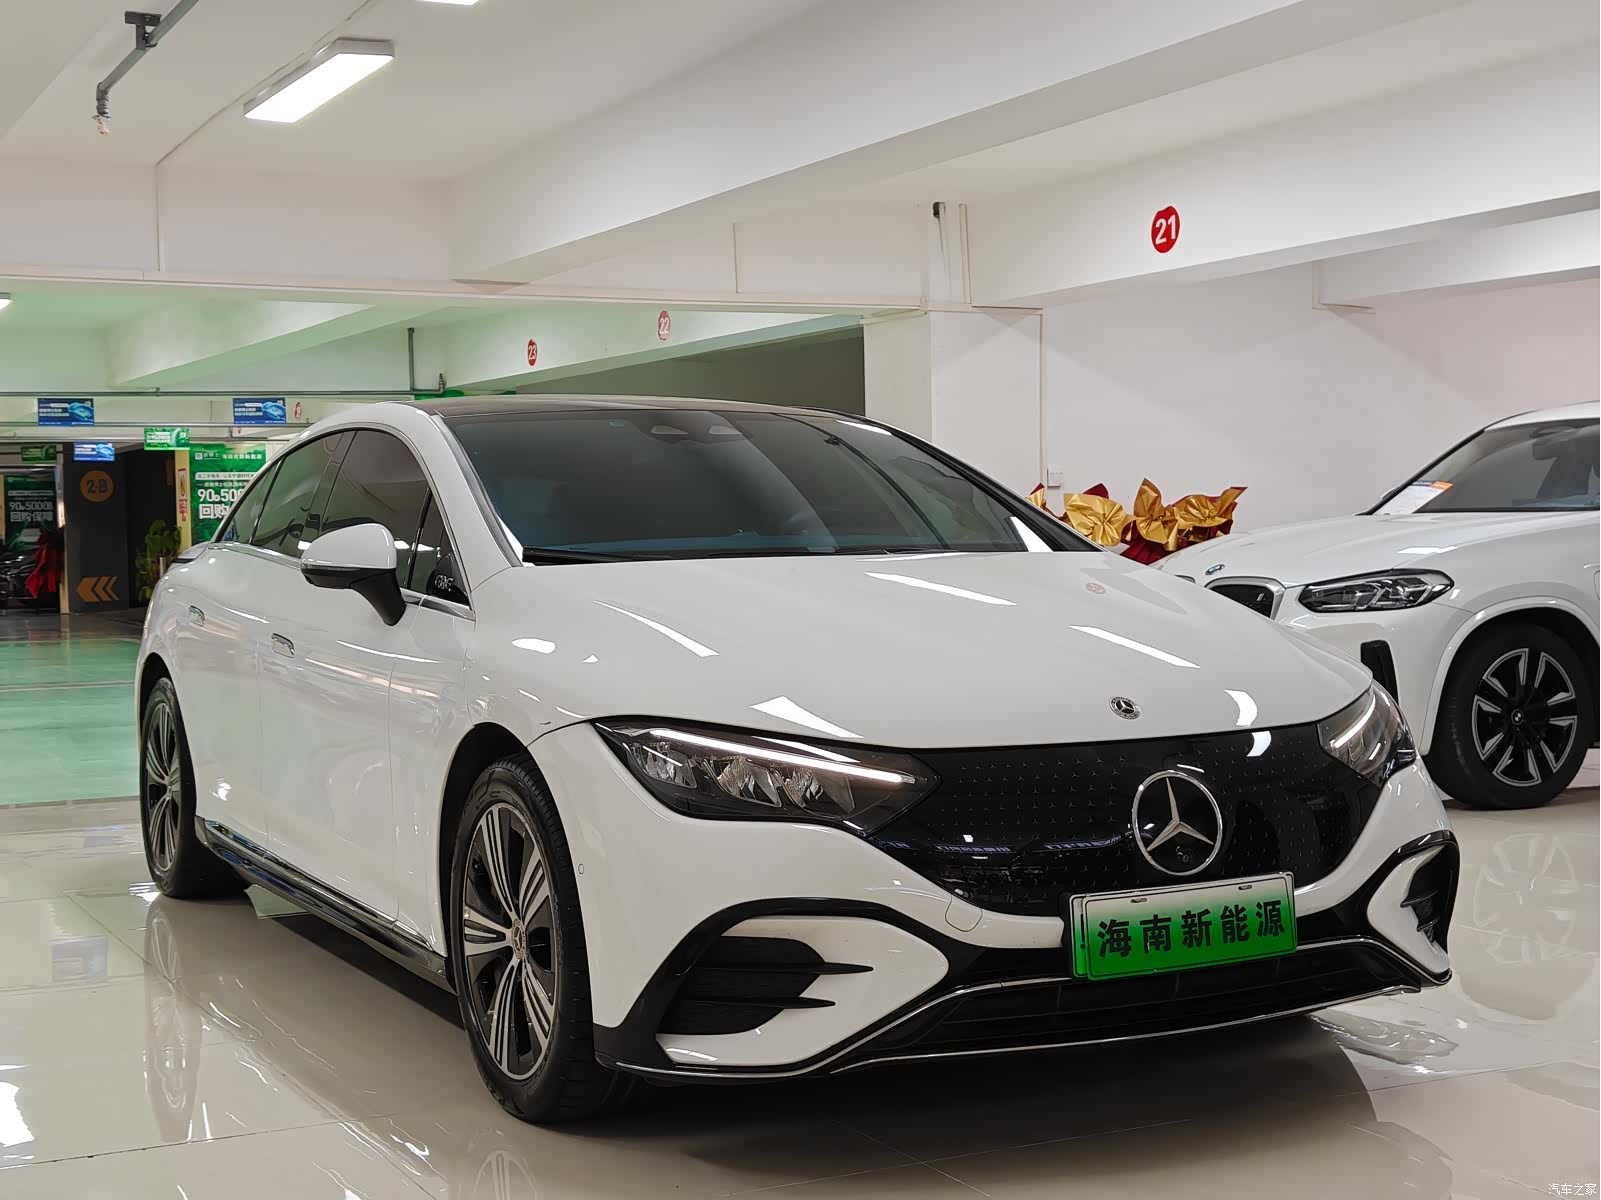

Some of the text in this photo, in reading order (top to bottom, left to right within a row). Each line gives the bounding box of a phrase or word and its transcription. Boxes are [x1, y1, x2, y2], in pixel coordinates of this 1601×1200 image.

[1155, 214, 1176, 245] 21
[658, 317, 670, 335] 22
[528, 344, 537, 361] 23
[1097, 900, 1286, 959] 海南新能源
